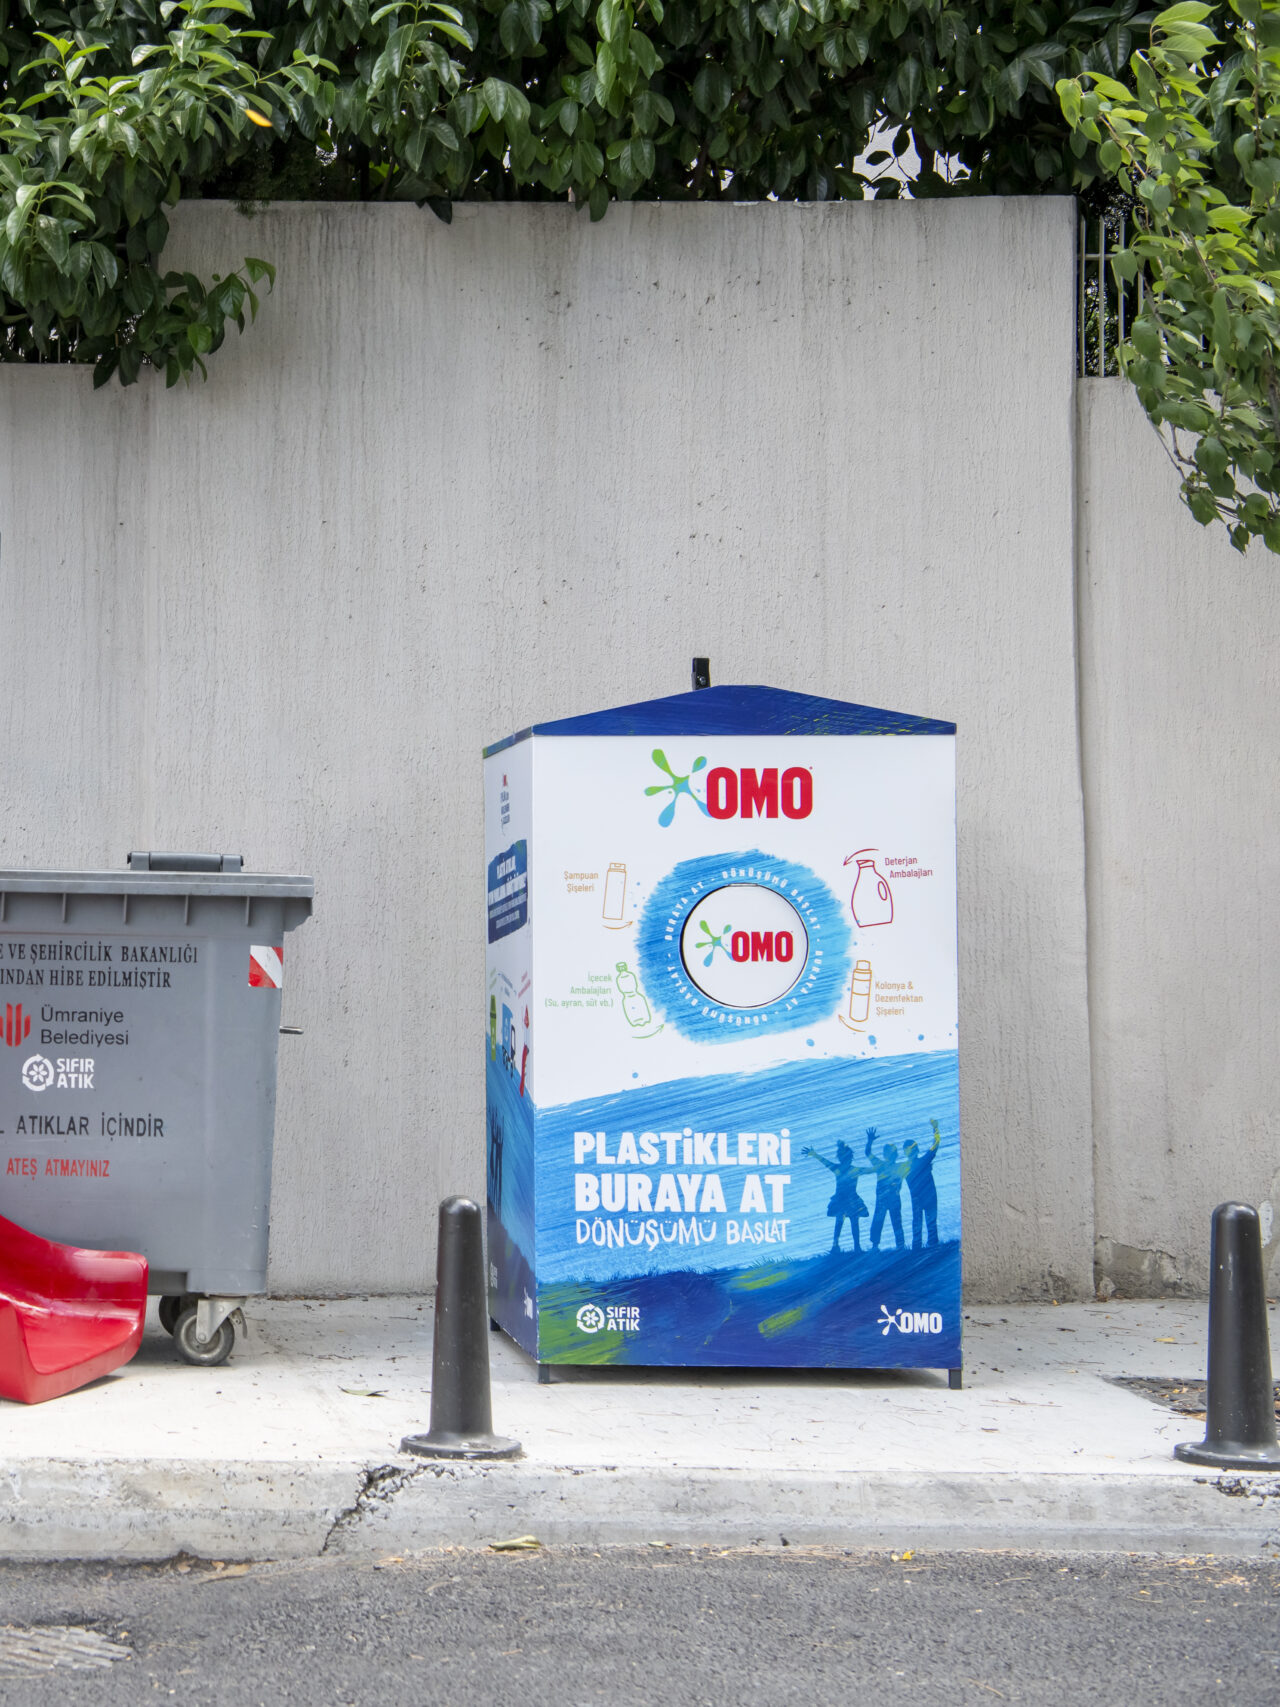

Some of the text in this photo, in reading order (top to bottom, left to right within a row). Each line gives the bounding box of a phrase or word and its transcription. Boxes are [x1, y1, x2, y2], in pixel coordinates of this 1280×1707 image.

[706, 766, 814, 820] OMO
[885, 857, 918, 868] Deterjan
[564, 870, 599, 881] Şampuan
[889, 868, 933, 878] Ambalajları
[567, 883, 595, 893] Şişeleri
[8, 943, 26, 960] VE
[30, 940, 113, 963] ŞEHİRCİLİK
[121, 944, 198, 963] BAKANLIĞI
[731, 930, 794, 962] OMO
[49, 965, 84, 986] HİBE
[88, 966, 171, 989] EDİLMİŞTİR
[875, 981, 906, 991] Kolonya
[570, 986, 612, 996] Ambalajları
[875, 993, 923, 1003] Dezenfektan
[41, 1004, 124, 1026] Ümraniye
[40, 1029, 129, 1047] Belediyesi
[57, 1058, 95, 1073] SIFIR
[56, 1073, 95, 1089] ATIK
[16, 1115, 89, 1135] ATIKLAR
[101, 1112, 164, 1141] İÇİNDİR
[574, 1128, 791, 1165] PLASTİKLERİ
[6, 1157, 110, 1181] ATEŞ ATMAYINIZ
[575, 1173, 791, 1213] BURAYA AT
[576, 1217, 791, 1251] DÖNÜŞÜMÜ BAŞLAT
[607, 1306, 640, 1319] SIFIR
[607, 1319, 640, 1331] ATIK
[900, 1312, 942, 1333] OMO
